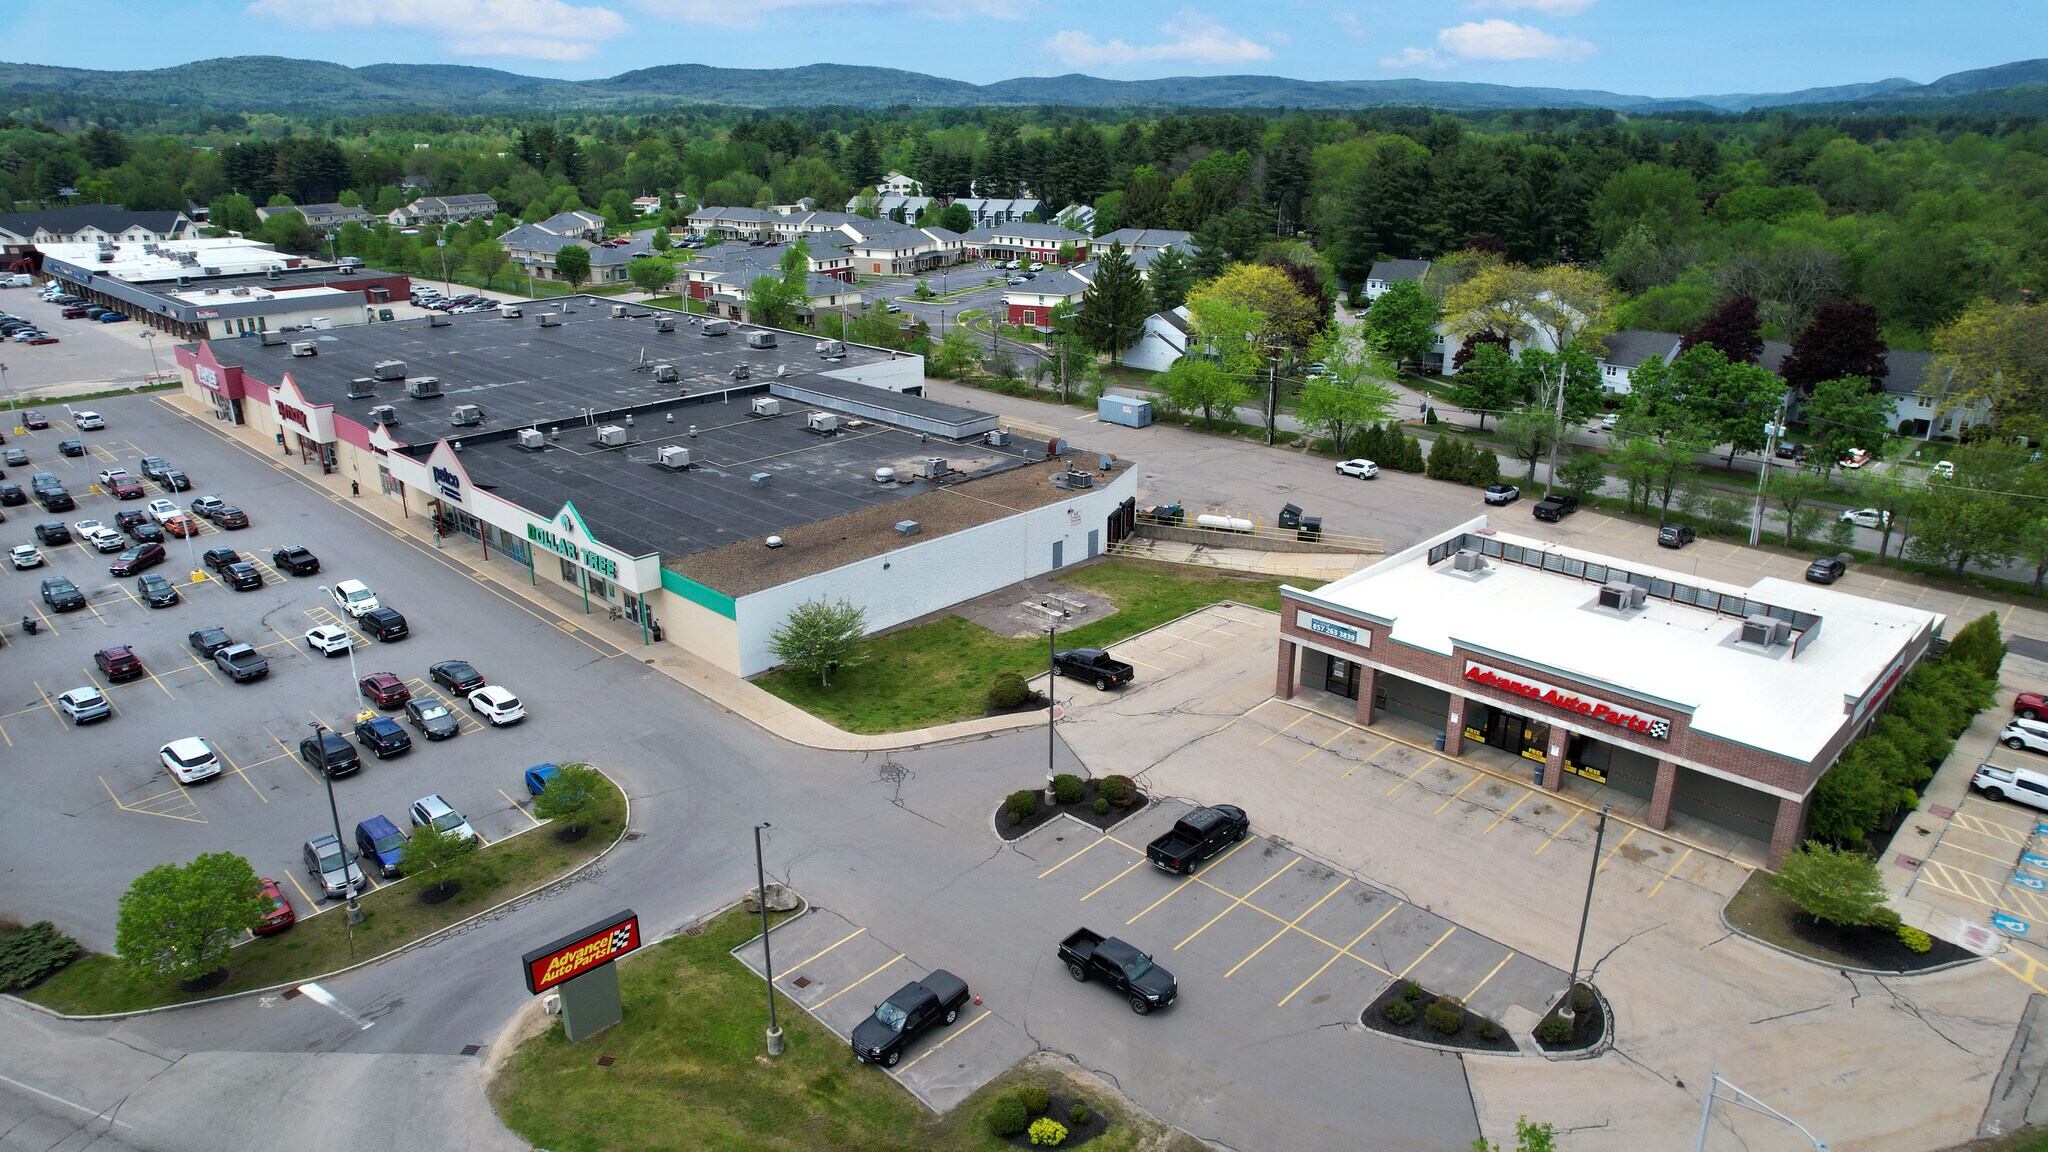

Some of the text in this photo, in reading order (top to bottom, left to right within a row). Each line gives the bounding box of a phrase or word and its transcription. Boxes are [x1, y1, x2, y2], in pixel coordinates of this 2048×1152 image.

[432, 465, 460, 489] petco
[527, 522, 617, 579] DOLLAR TREE
[1312, 623, 1325, 632] 857
[1325, 627, 1338, 636] 263
[1338, 630, 1355, 642] 3839
[1464, 666, 1648, 734] Advance Auto Parts
[1466, 726, 1481, 736] FREE
[1528, 747, 1544, 757] FREE
[1585, 766, 1601, 776] FREE
[540, 948, 607, 985] Auto Parts
[547, 936, 608, 973] Advance
